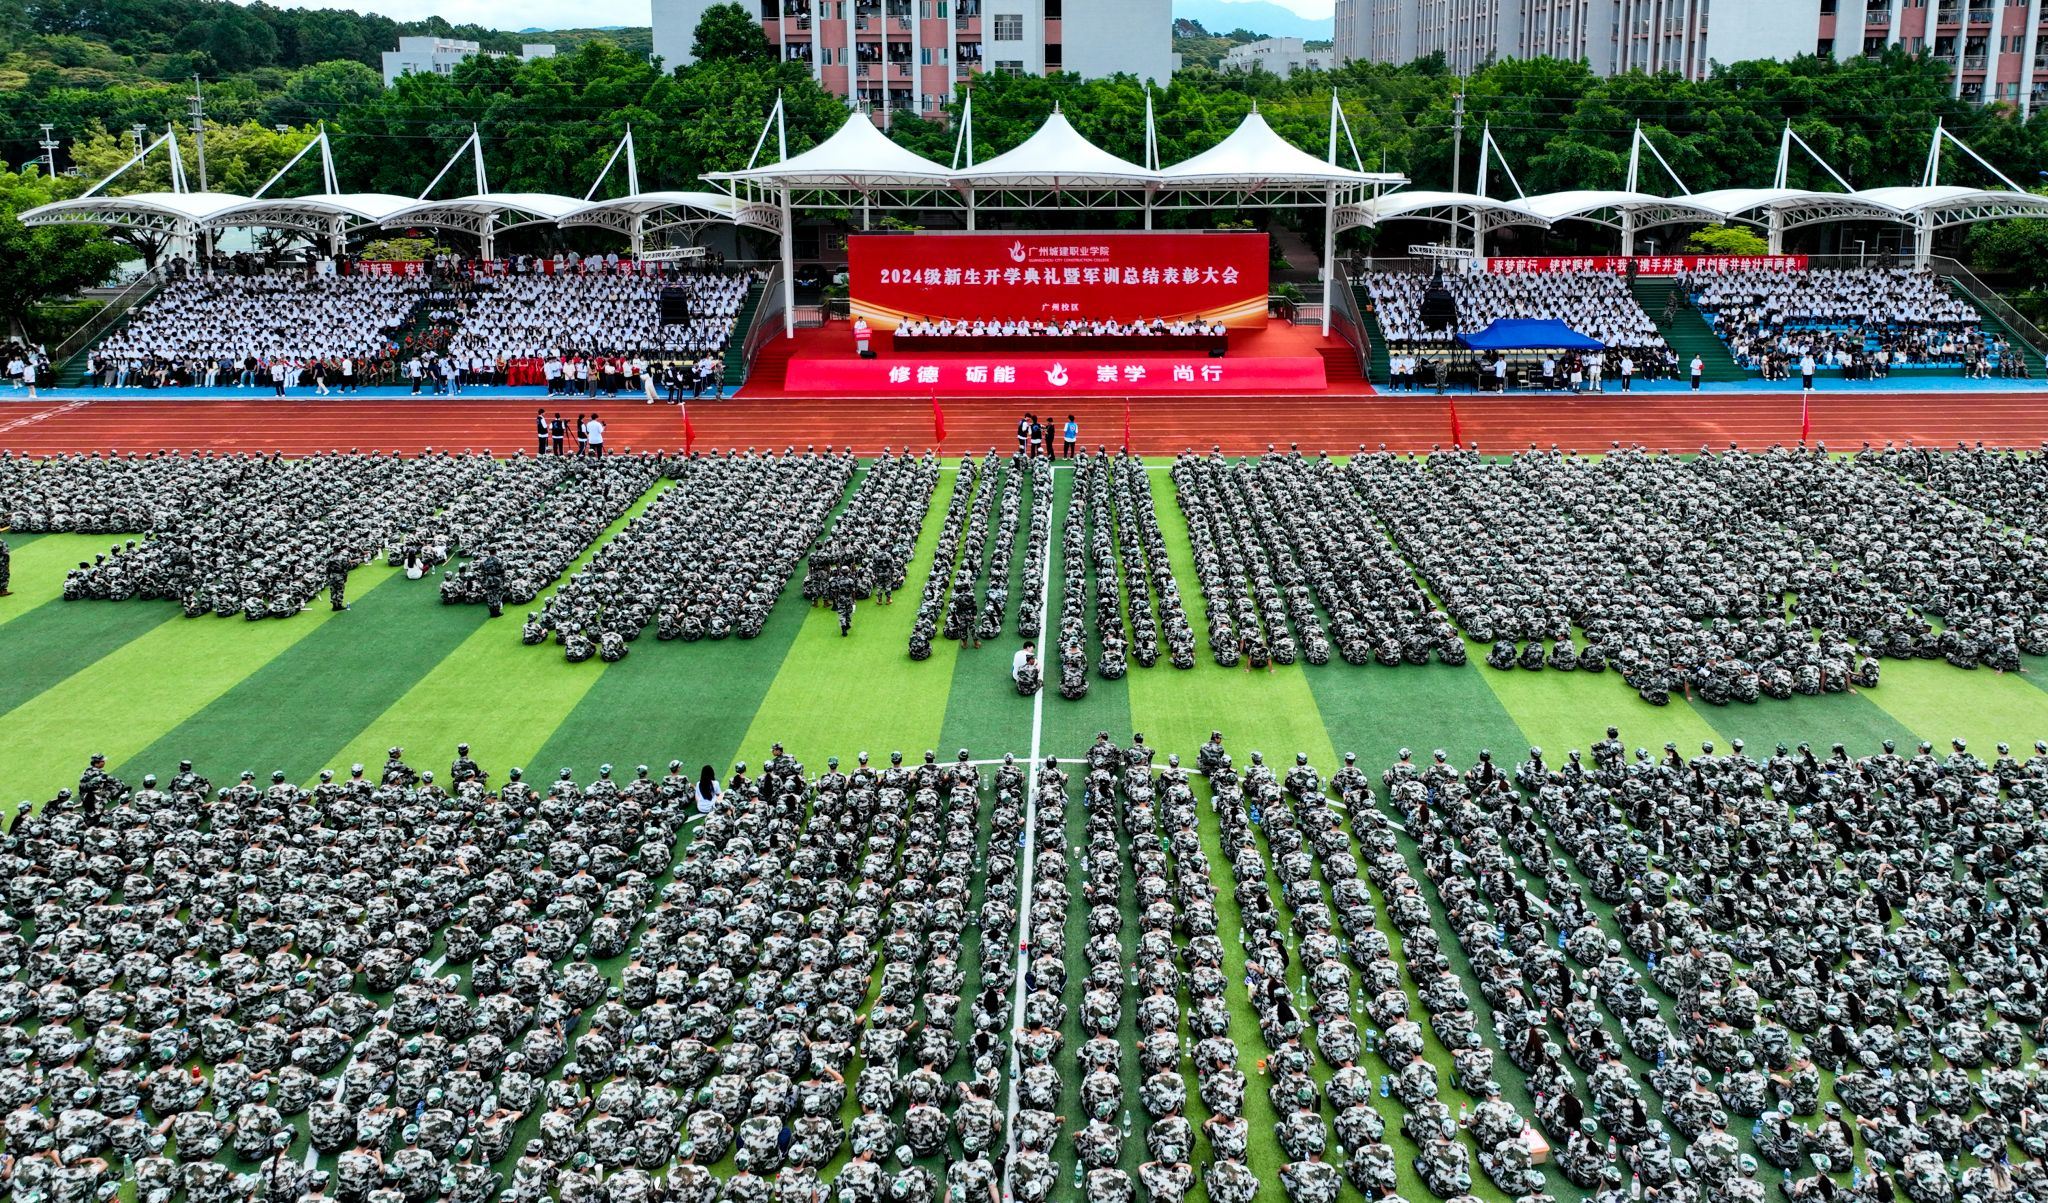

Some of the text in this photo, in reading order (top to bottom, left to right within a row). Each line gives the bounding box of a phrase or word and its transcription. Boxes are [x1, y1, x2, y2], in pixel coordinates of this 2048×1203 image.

[1028, 246, 1110, 257] 广州城建职业学院
[880, 266, 1240, 286] 2024级新生开学典礼暨军训总结表彰大会
[1041, 303, 1080, 312] 广州校区
[888, 364, 1224, 384] 修德 砺能 崇学 尚行
